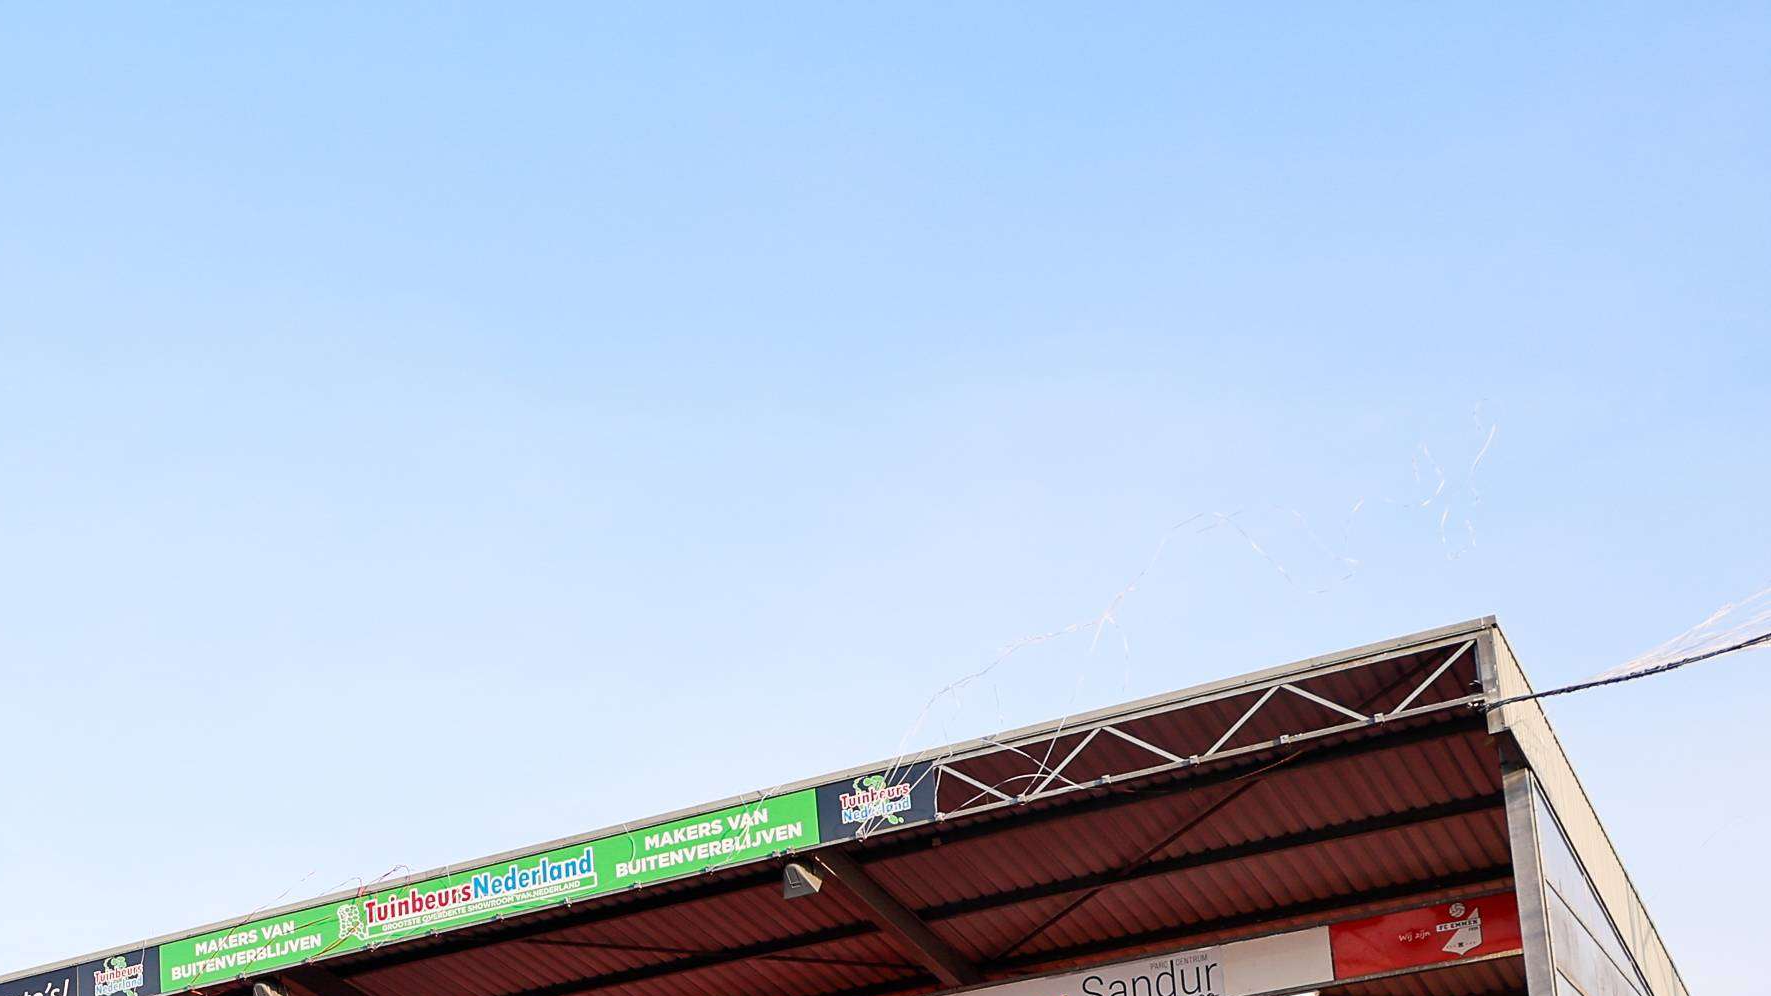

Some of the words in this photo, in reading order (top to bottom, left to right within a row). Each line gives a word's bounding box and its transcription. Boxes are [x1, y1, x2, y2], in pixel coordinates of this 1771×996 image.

[615, 821, 803, 879] BUITENVERBLIJVEN
[644, 818, 723, 851] MAKERS
[727, 808, 769, 831] VAN
[382, 915, 423, 932] GROOTSTE
[422, 906, 468, 924] OVERDEKTE
[467, 896, 515, 914] SHOWROOM
[532, 880, 581, 898] NEDERLAND
[171, 933, 323, 981] BUITENVERBLIJVEN
[195, 931, 258, 956] MAKERS
[261, 920, 295, 941] VAN
[94, 963, 144, 986] Tuinbeurs
[94, 975, 144, 996] Nederland
